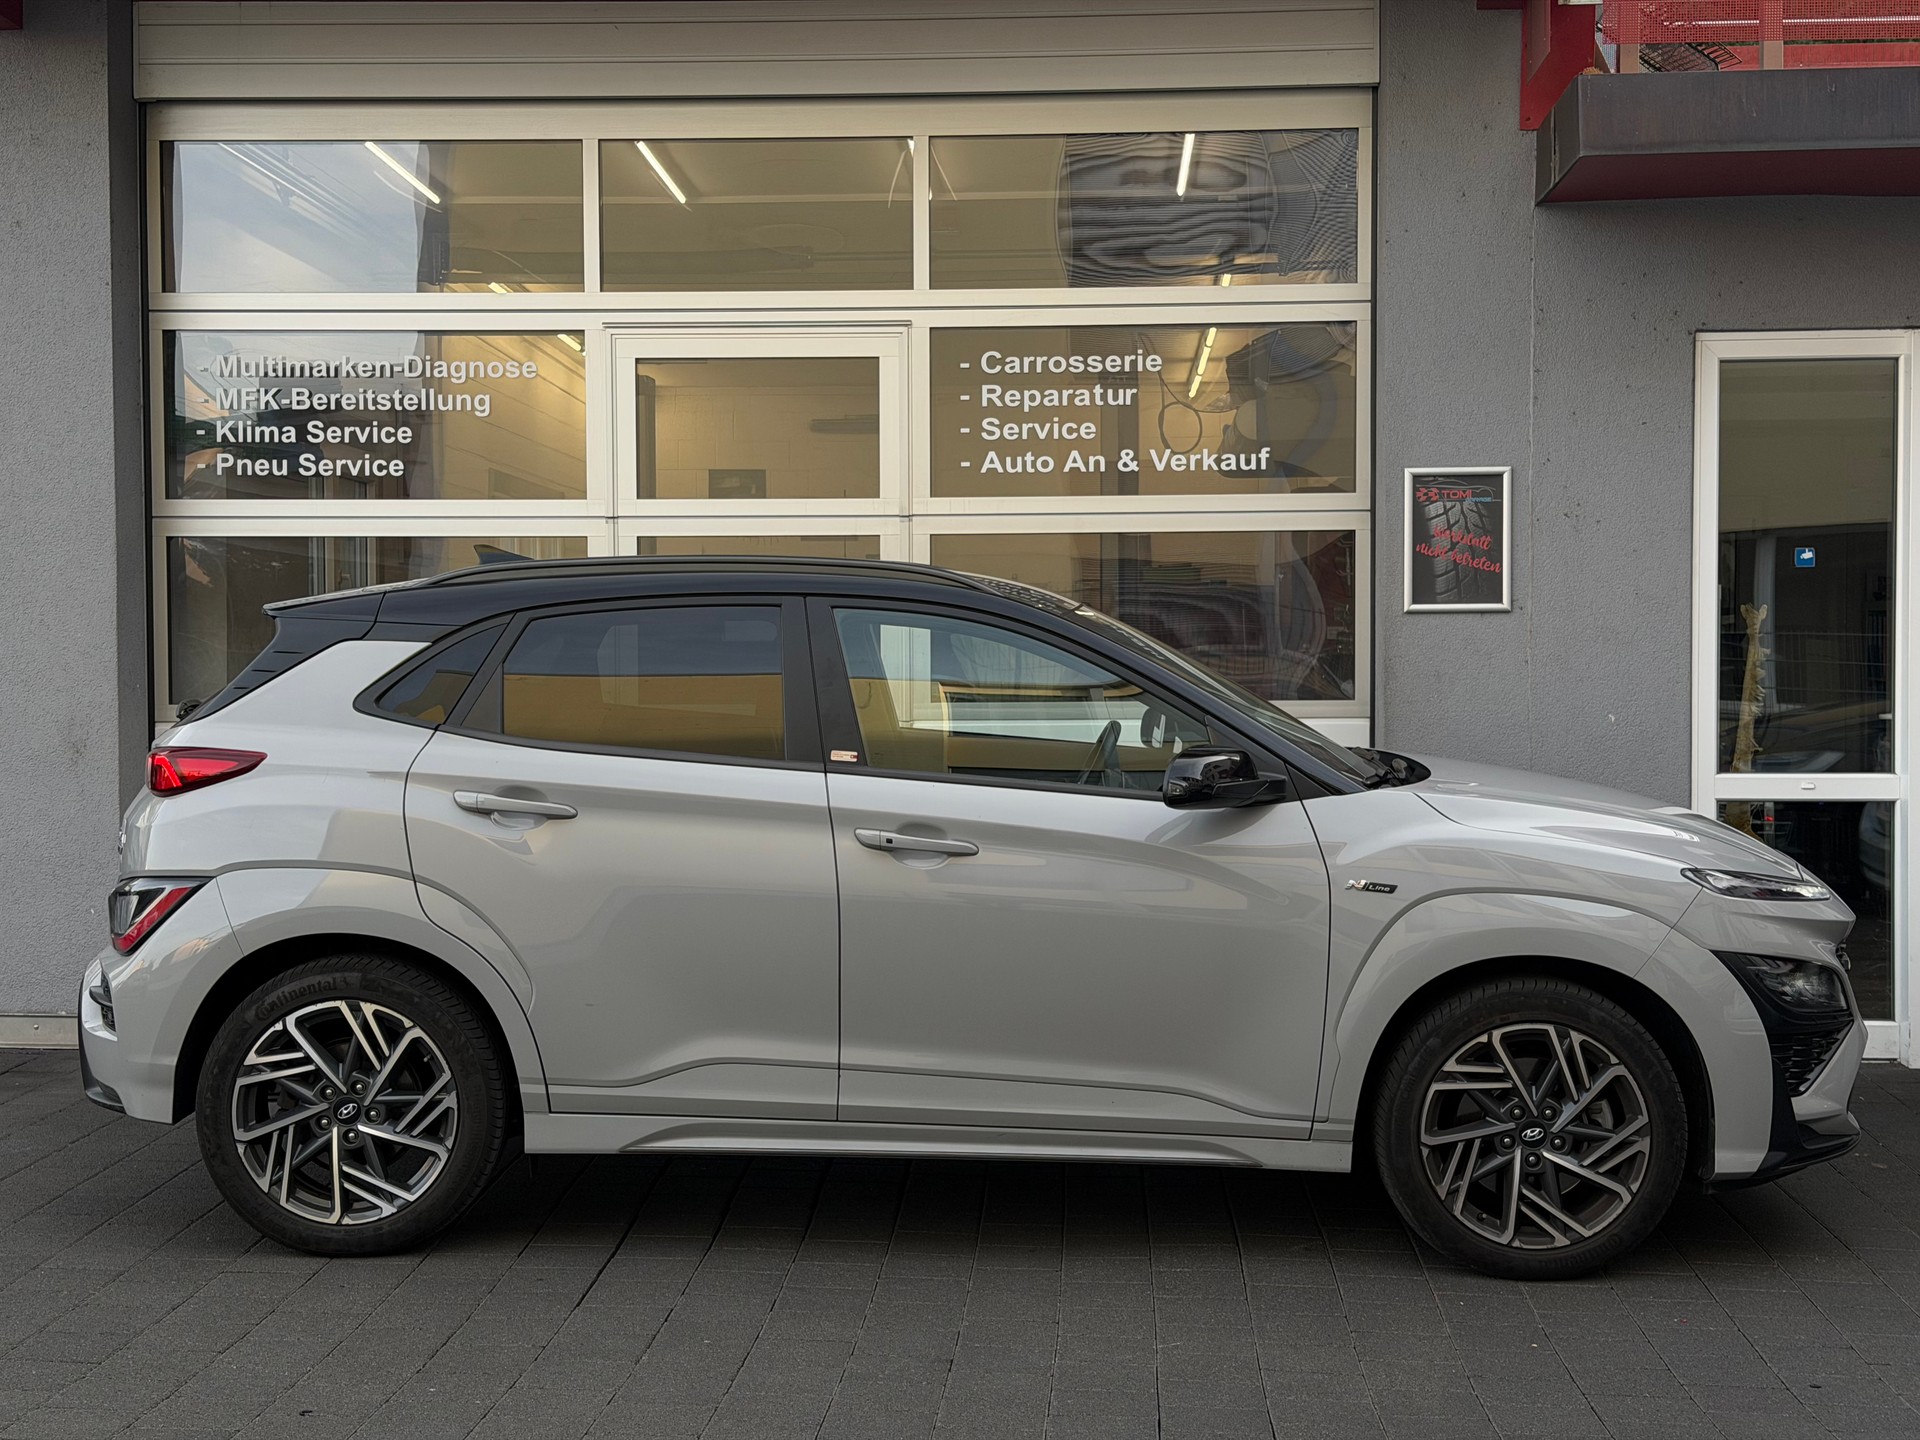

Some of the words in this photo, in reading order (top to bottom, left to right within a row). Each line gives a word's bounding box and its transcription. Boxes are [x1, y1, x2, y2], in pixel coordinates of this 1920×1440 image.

[215, 354, 538, 384] Multimarken-Diagnose
[980, 350, 1163, 375] Carrosserie
[215, 387, 491, 417] MFK-Bereitstellung
[980, 384, 1138, 412] Reparatur
[215, 420, 297, 444] Klima
[306, 420, 413, 444] Service
[980, 417, 1097, 441] Service
[215, 453, 288, 477] Pneu
[298, 453, 405, 477] Service
[980, 450, 1055, 474] Auto
[1063, 449, 1106, 473] An
[1117, 449, 1140, 473] &
[1149, 447, 1271, 472] Verkauf
[1441, 489, 1473, 499] TOMI
[1451, 548, 1501, 573] betreten
[1368, 884, 1391, 892] Line
[255, 977, 338, 1020] Continental
